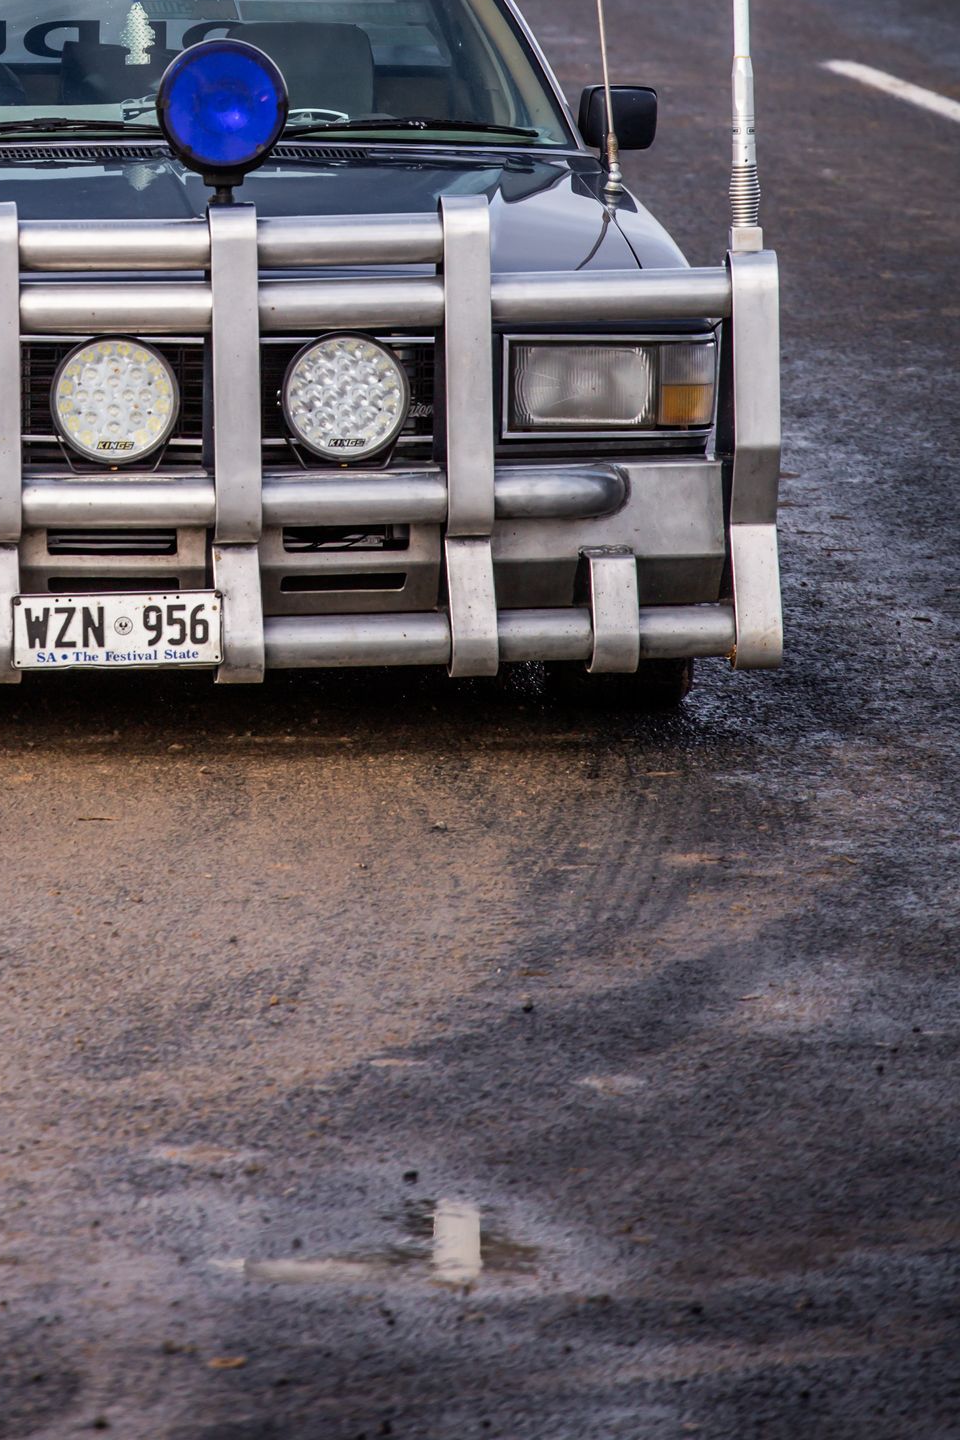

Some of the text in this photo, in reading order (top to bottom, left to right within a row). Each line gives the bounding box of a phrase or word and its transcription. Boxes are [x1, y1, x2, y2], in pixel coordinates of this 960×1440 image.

[96, 441, 135, 450] KINGS
[327, 438, 366, 447] KINGS
[24, 603, 209, 649] WZN 956
[36, 649, 199, 663] SA The Festival State
